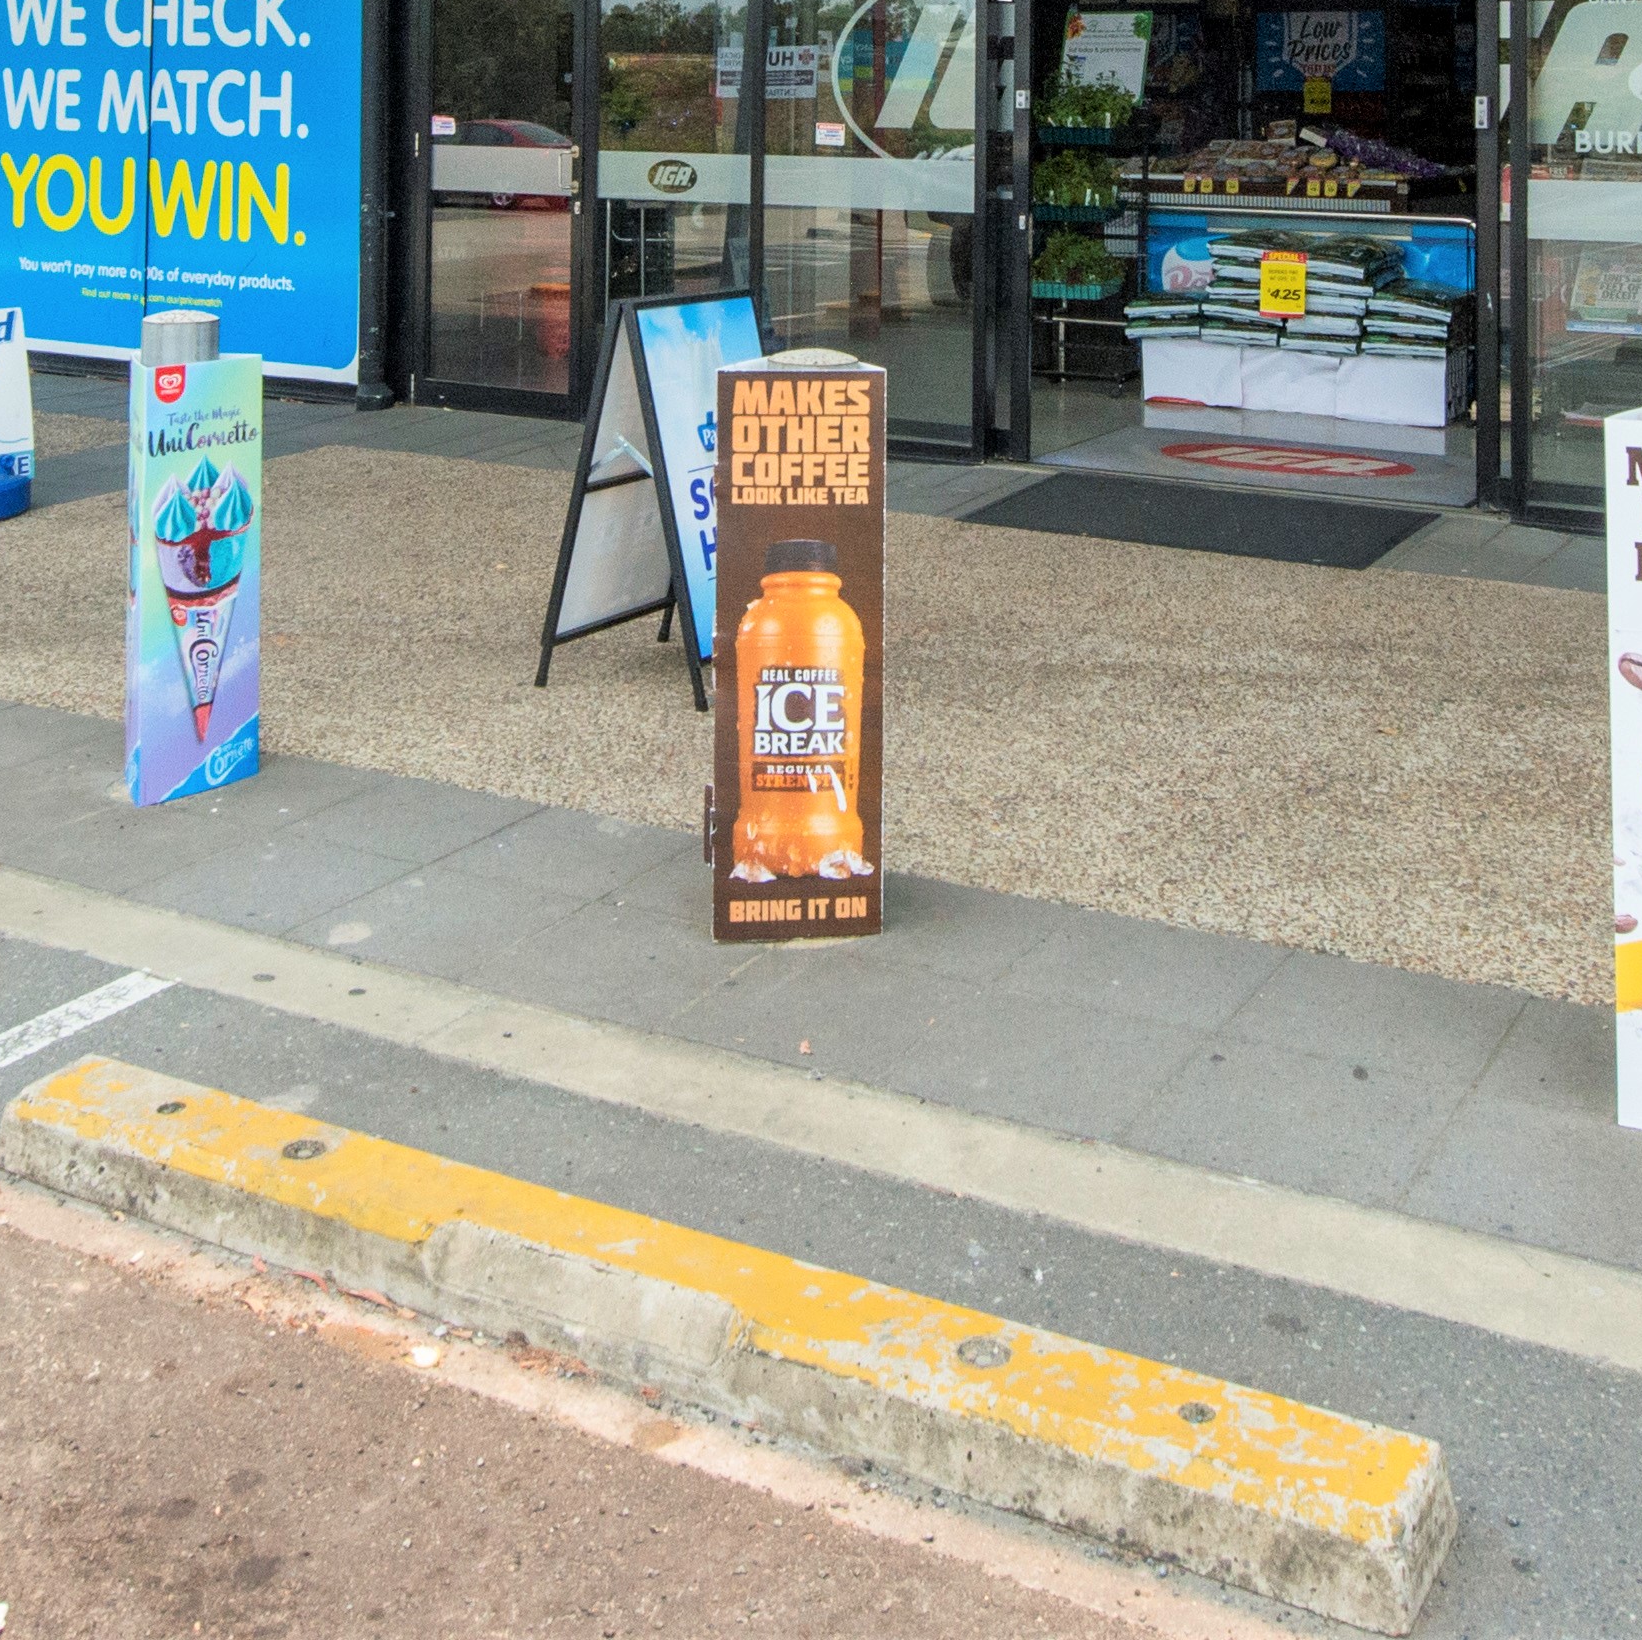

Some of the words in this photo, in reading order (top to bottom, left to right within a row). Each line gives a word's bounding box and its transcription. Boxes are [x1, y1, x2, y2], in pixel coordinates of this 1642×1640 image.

[1299, 14, 1341, 40] Low
[1287, 36, 1353, 61] Prices
[2, 67, 82, 131] WE
[97, 68, 309, 139] MATCH.
[651, 165, 693, 188] IGA
[0, 151, 136, 237] YOU
[148, 157, 307, 247] WIN.
[18, 257, 39, 272] You
[41, 258, 72, 275] won't
[73, 260, 95, 279] pay
[97, 264, 128, 279] more
[167, 267, 180, 283] of
[181, 271, 236, 289] everyday
[238, 274, 296, 292] products.
[732, 379, 871, 416] MAKES
[193, 409, 209, 422] the
[211, 405, 242, 421] Magic
[147, 419, 260, 458] UniCornetto
[731, 415, 871, 453] OTHER
[731, 452, 871, 487] COFFEE
[1175, 446, 1400, 474] IGA
[731, 486, 783, 505] LOOK
[786, 486, 829, 505] LIKE
[832, 486, 870, 505] TEA
[761, 668, 792, 683] REAL
[794, 668, 839, 683] COFFEE
[754, 682, 845, 732] ICE
[754, 731, 845, 755] BREAK
[728, 898, 803, 923] BRING
[807, 897, 831, 920] IT
[834, 895, 868, 919] ON
